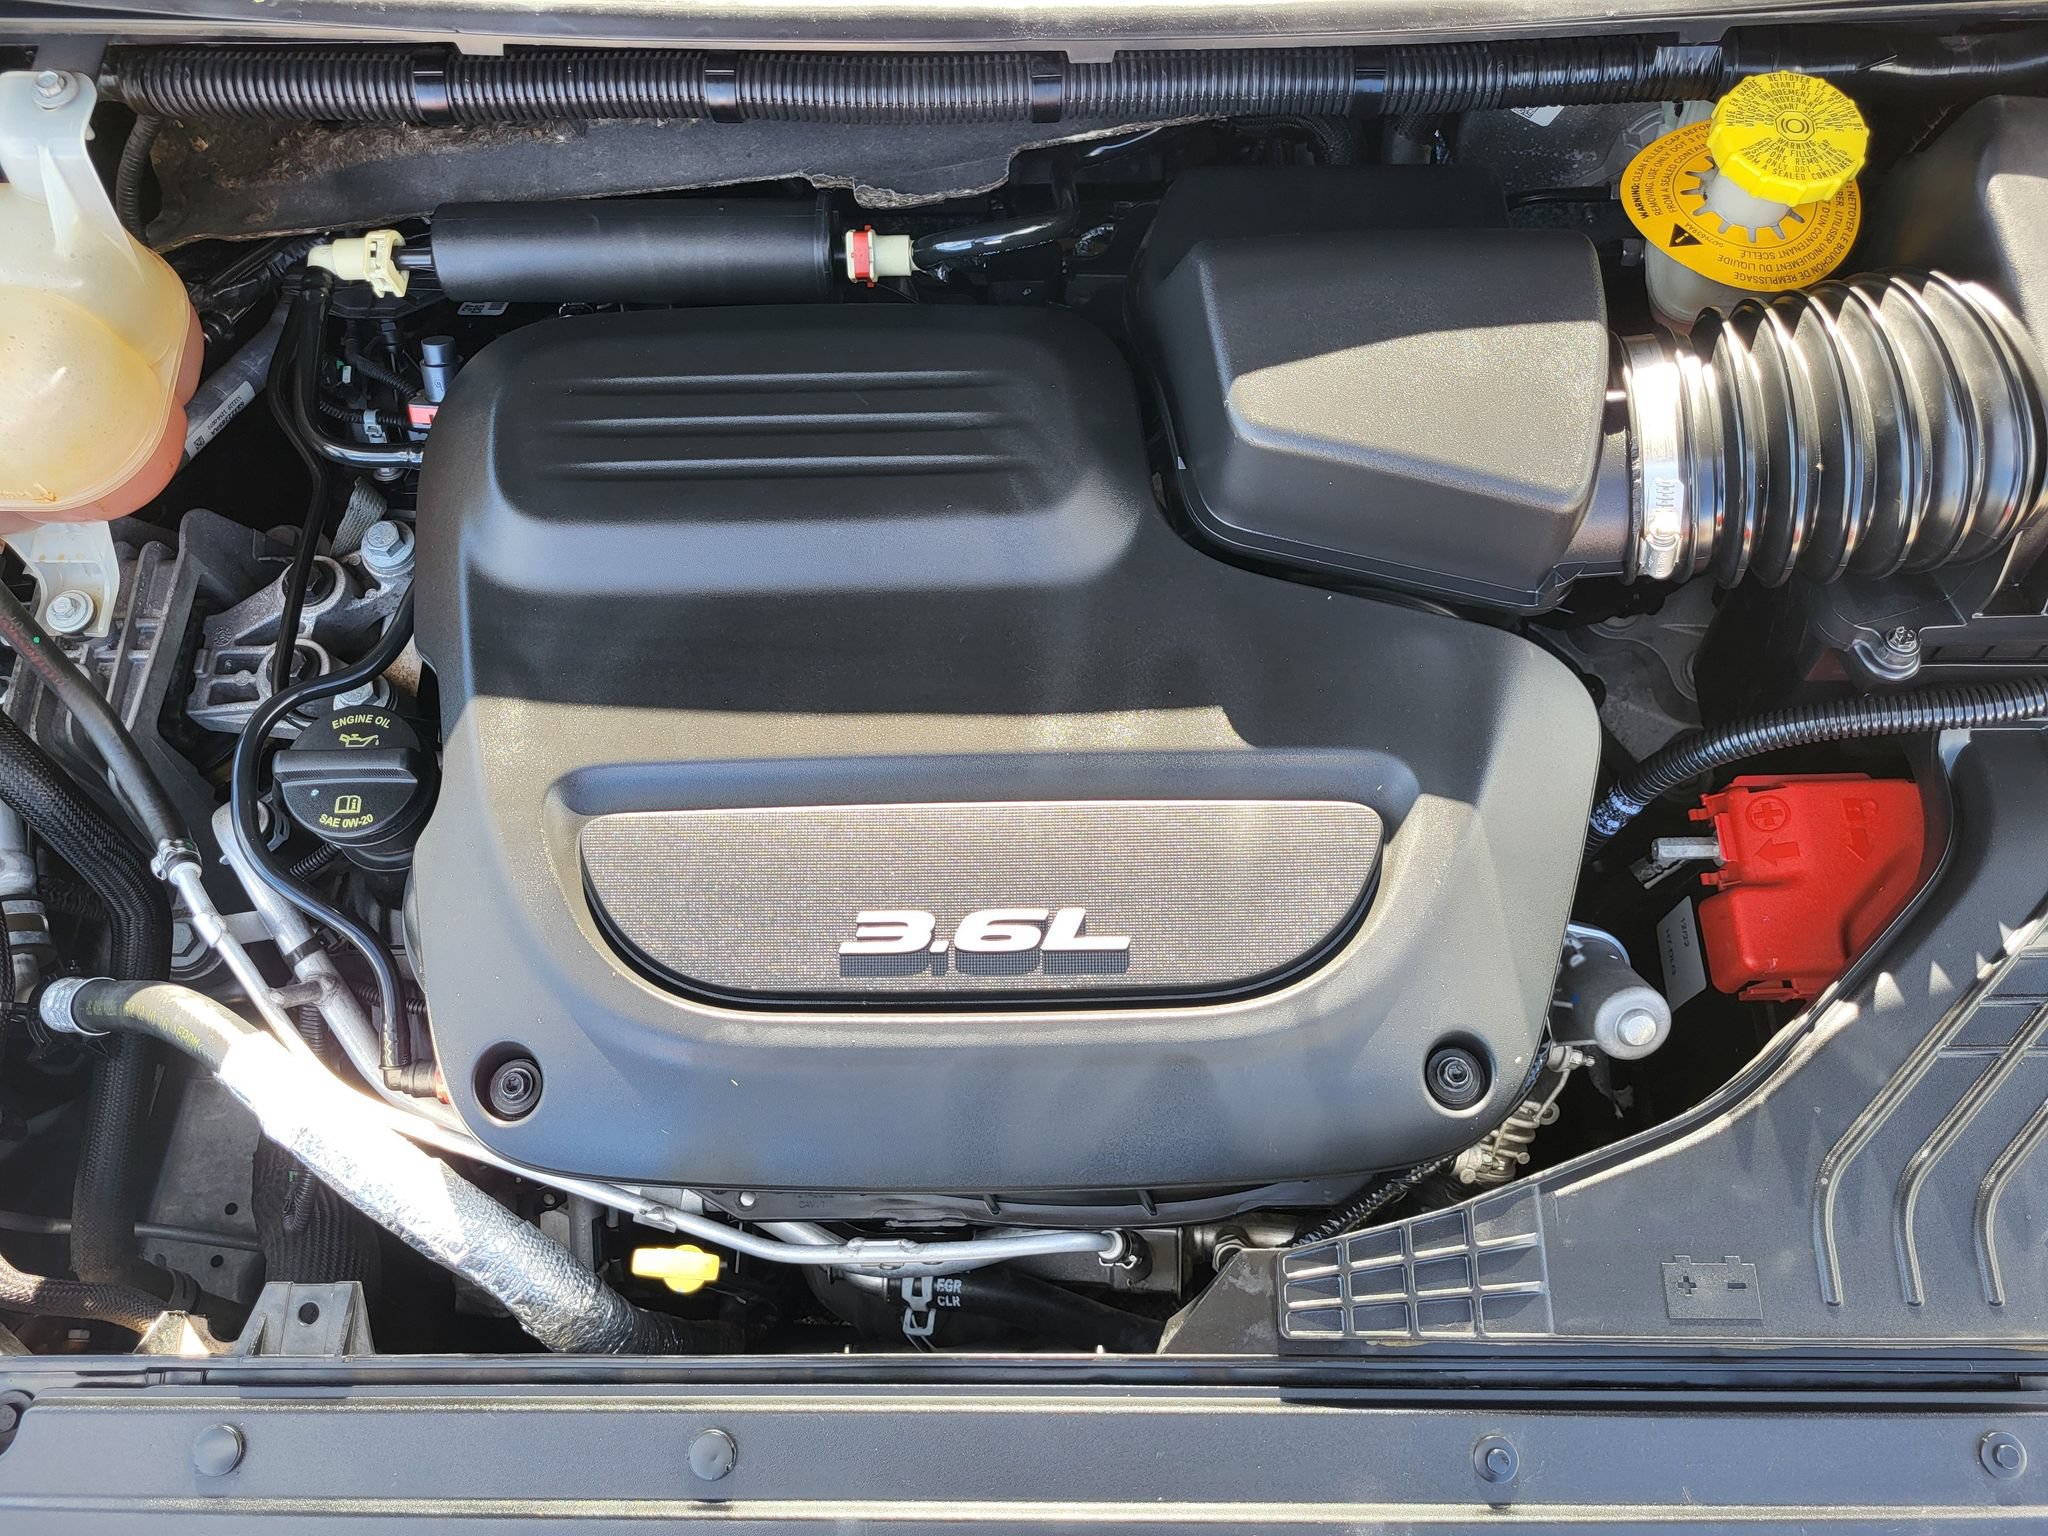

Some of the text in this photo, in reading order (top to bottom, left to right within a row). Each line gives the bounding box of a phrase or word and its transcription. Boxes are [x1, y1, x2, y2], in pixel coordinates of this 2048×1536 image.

[1768, 73, 1811, 84] NETTOYER
[1816, 82, 1827, 91] LE
[1729, 98, 1739, 107] EN
[1735, 86, 1766, 124] REMPLISSAGE
[1769, 82, 1796, 90] AVANT
[1801, 83, 1811, 92] DE
[1815, 90, 1826, 98] LE
[1745, 89, 1843, 131] UTILISER UNIQUEMENT DU LIQUIDE
[1755, 109, 1767, 122] DOT
[1770, 96, 1818, 109] PROVENANT
[1830, 91, 1859, 119] BOUCHON
[1727, 109, 1736, 127] MISE
[1764, 104, 1799, 126] CONTENANT
[1670, 141, 1687, 153] DOT
[1755, 141, 1788, 163] BEFORE
[1763, 137, 1831, 157] CLEAN FILLER CAP
[1632, 161, 1648, 181] CLEAN
[1644, 145, 1665, 163] FILLER
[1664, 135, 1680, 146] CAP
[1653, 151, 1672, 168] ONLY
[1739, 147, 1760, 165] FROM
[1772, 168, 1805, 180] SEALED
[1747, 145, 1763, 158] USE
[1766, 158, 1788, 170] ONLY
[1825, 150, 1847, 168] FLUID
[1647, 167, 1660, 180] USE
[1661, 164, 1677, 187] SEALED
[1663, 195, 1677, 213] FROM
[1844, 190, 1857, 232] NETTOYER
[1823, 211, 1843, 244] UTILISER
[1778, 227, 1822, 259] CONTENANT
[1840, 232, 1850, 244] LE
[1717, 255, 1755, 270] LIQUIDE
[1775, 243, 1828, 271] UNIQUEMENT
[1810, 242, 1845, 274] BOUCHON
[1733, 271, 1798, 285] REMPLISSAGE
[1759, 264, 1773, 272] DU
[1798, 270, 1811, 280] DE
[332, 714, 391, 730] ENGINE OIL
[319, 813, 374, 828] SAE 0W-20
[839, 907, 1131, 955] 3.6L
[936, 1278, 962, 1293] EGR
